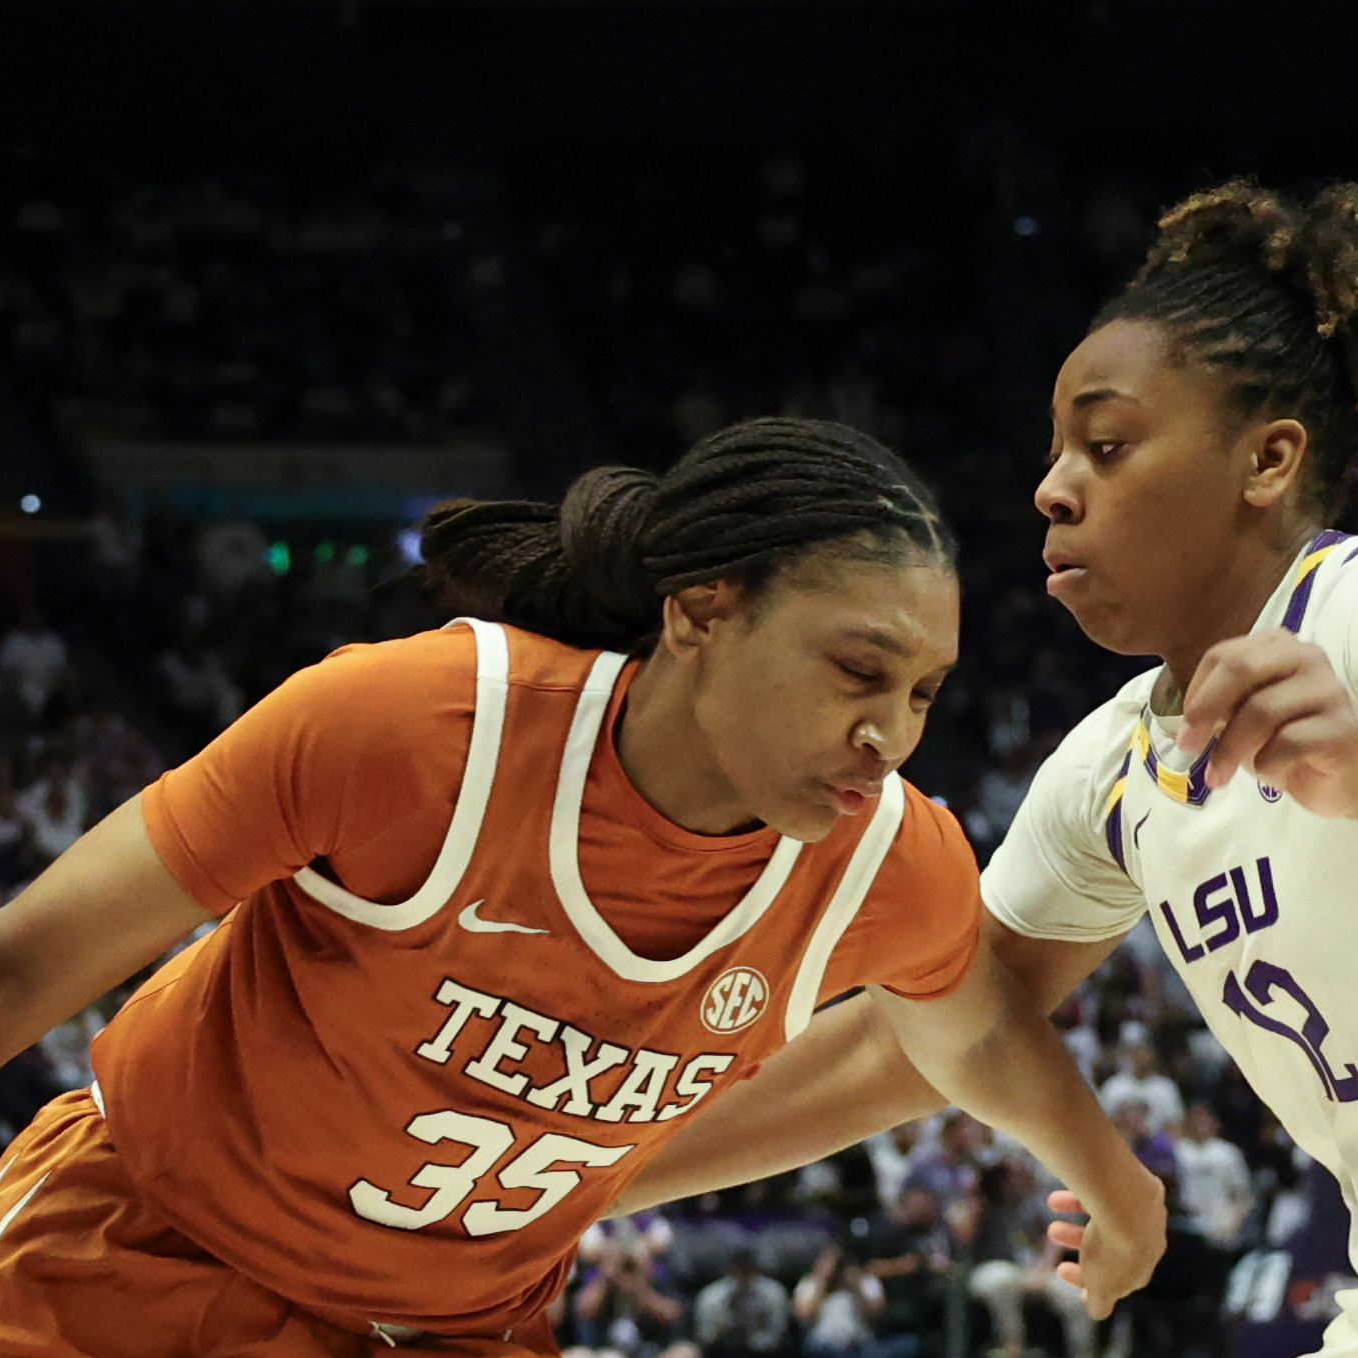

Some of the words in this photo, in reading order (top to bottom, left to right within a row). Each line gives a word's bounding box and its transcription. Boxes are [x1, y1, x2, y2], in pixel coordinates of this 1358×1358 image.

[1159, 856, 1279, 964] LSU
[414, 977, 738, 1123] TEXAS
[706, 972, 764, 1029] SEC
[348, 1110, 638, 1237] 35
